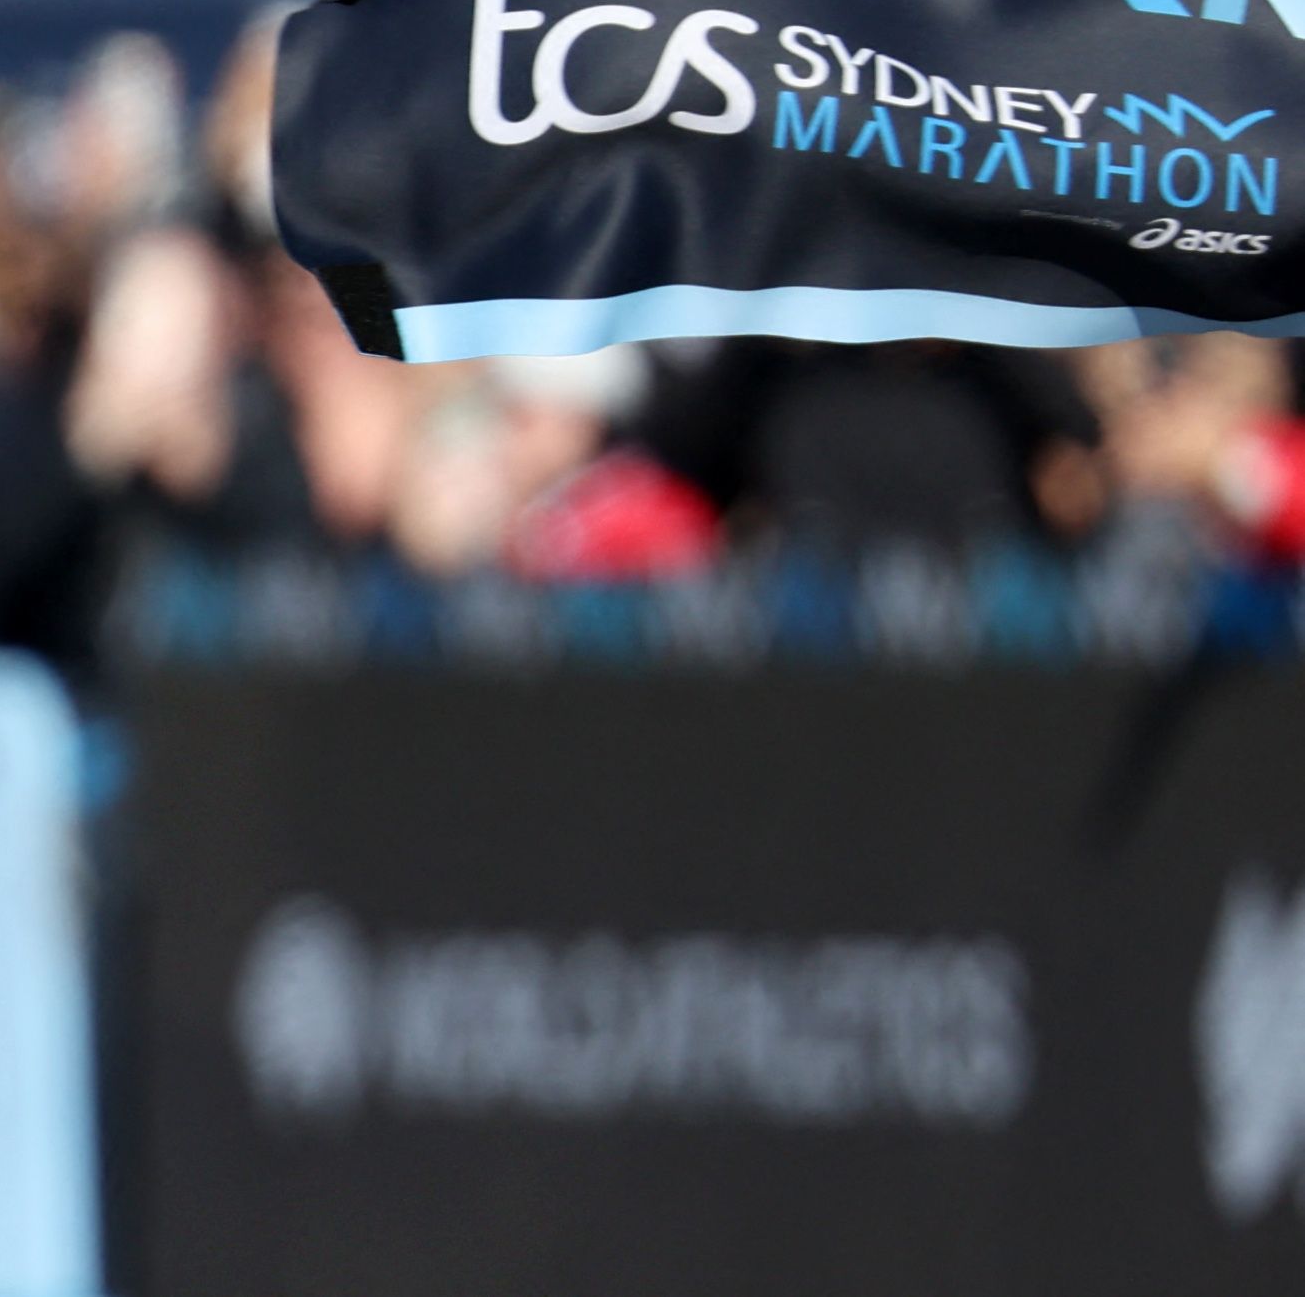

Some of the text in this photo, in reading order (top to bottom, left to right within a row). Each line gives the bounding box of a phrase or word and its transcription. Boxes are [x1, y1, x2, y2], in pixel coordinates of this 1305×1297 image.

[774, 25, 1097, 139] SYDNEY
[772, 90, 1279, 217] MARATHON
[1174, 228, 1273, 255] asics
